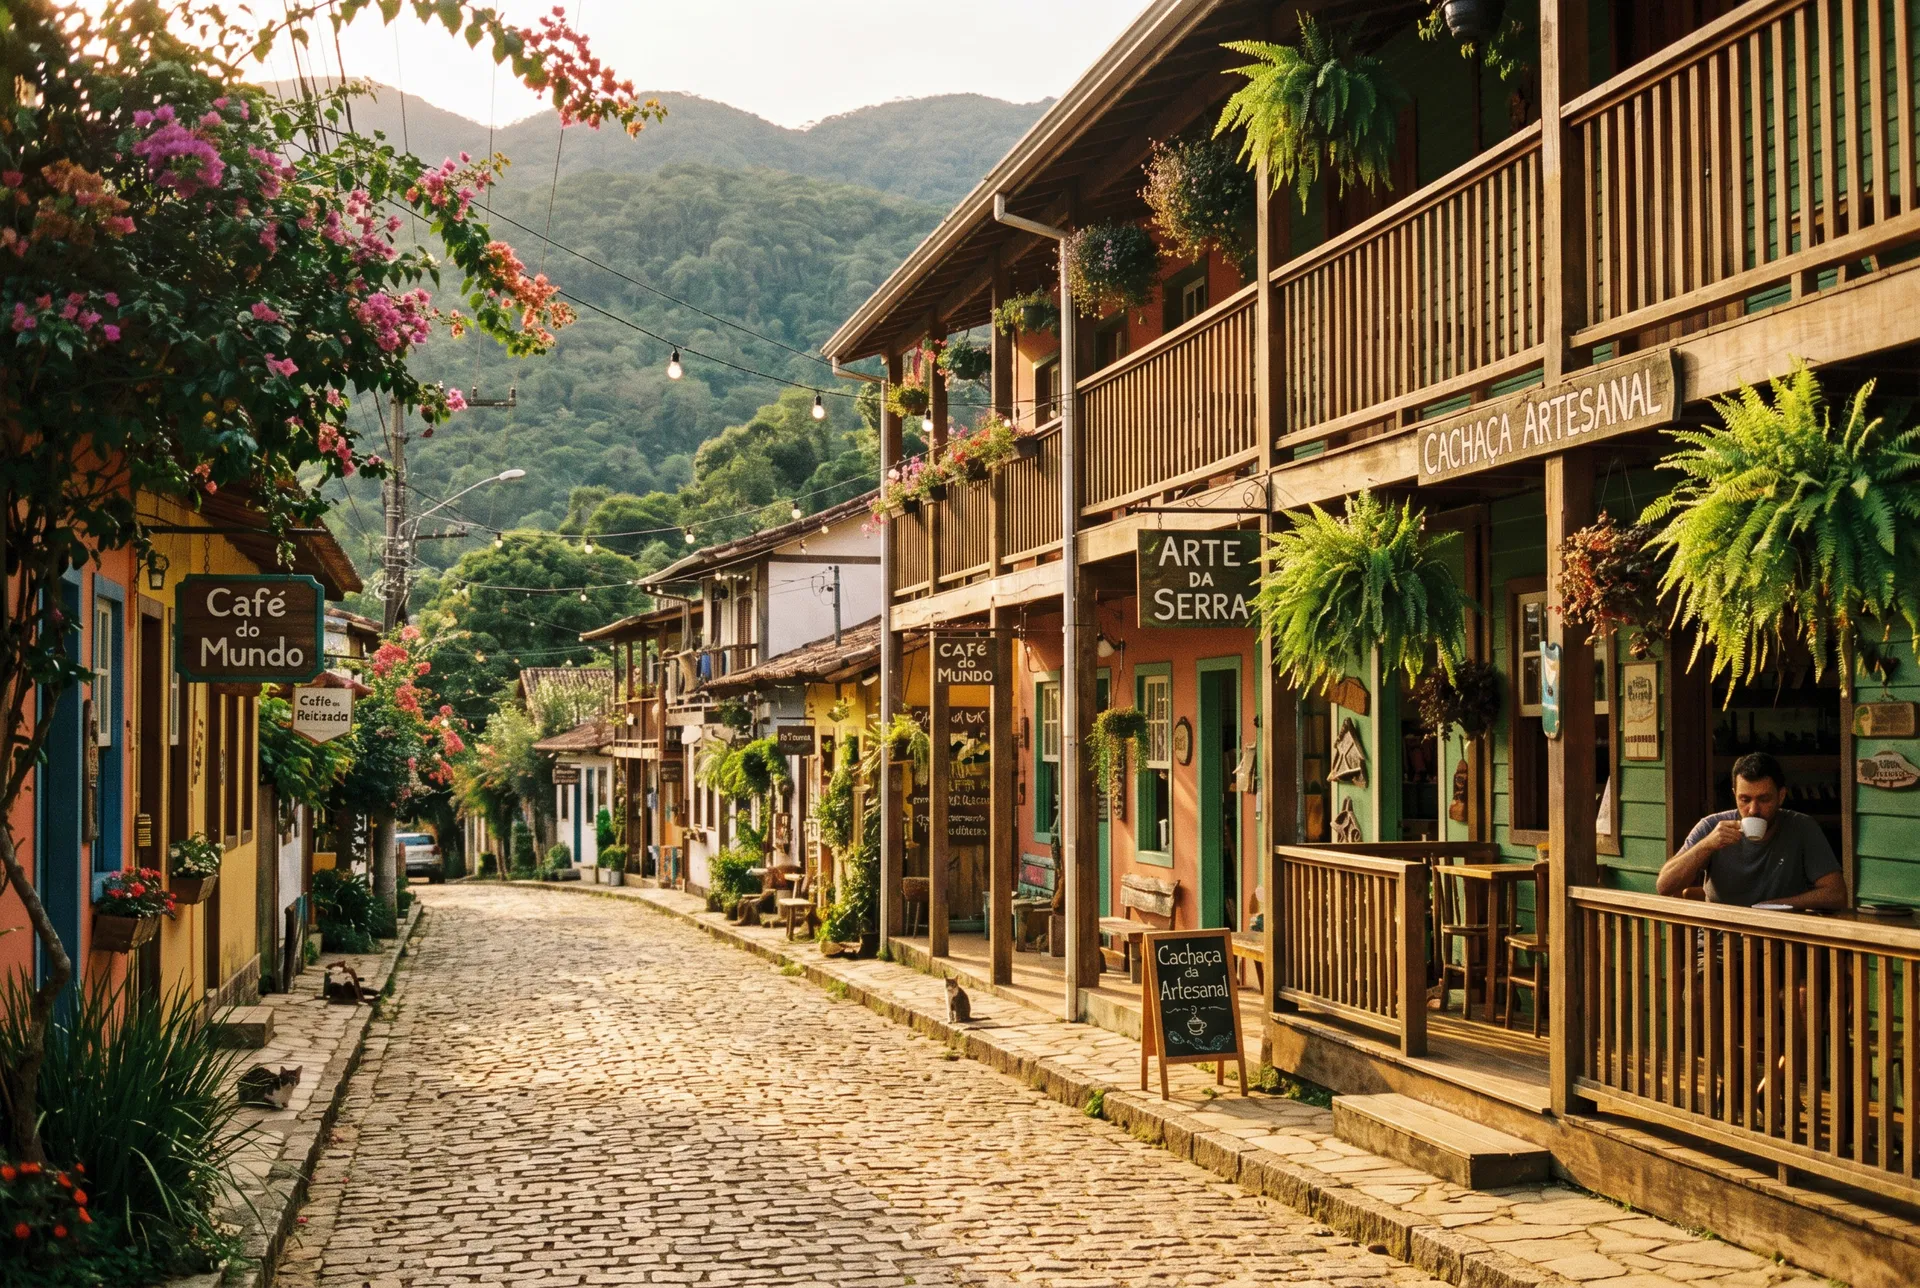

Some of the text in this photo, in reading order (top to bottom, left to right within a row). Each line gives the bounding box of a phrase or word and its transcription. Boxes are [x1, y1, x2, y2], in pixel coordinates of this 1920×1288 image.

[1424, 368, 1662, 475] CACHAÇA ARTESANAL
[1158, 535, 1241, 567] ARTE
[1189, 571, 1215, 588] DA
[206, 587, 286, 618] Café
[1154, 588, 1249, 621] SERRA
[235, 620, 260, 638] do
[200, 636, 304, 668] Mundo
[957, 656, 976, 668] do
[937, 668, 993, 682] MUNDO
[1158, 943, 1222, 966] Cachaça
[1184, 967, 1199, 978] da
[1160, 975, 1229, 1001] Artesanal
